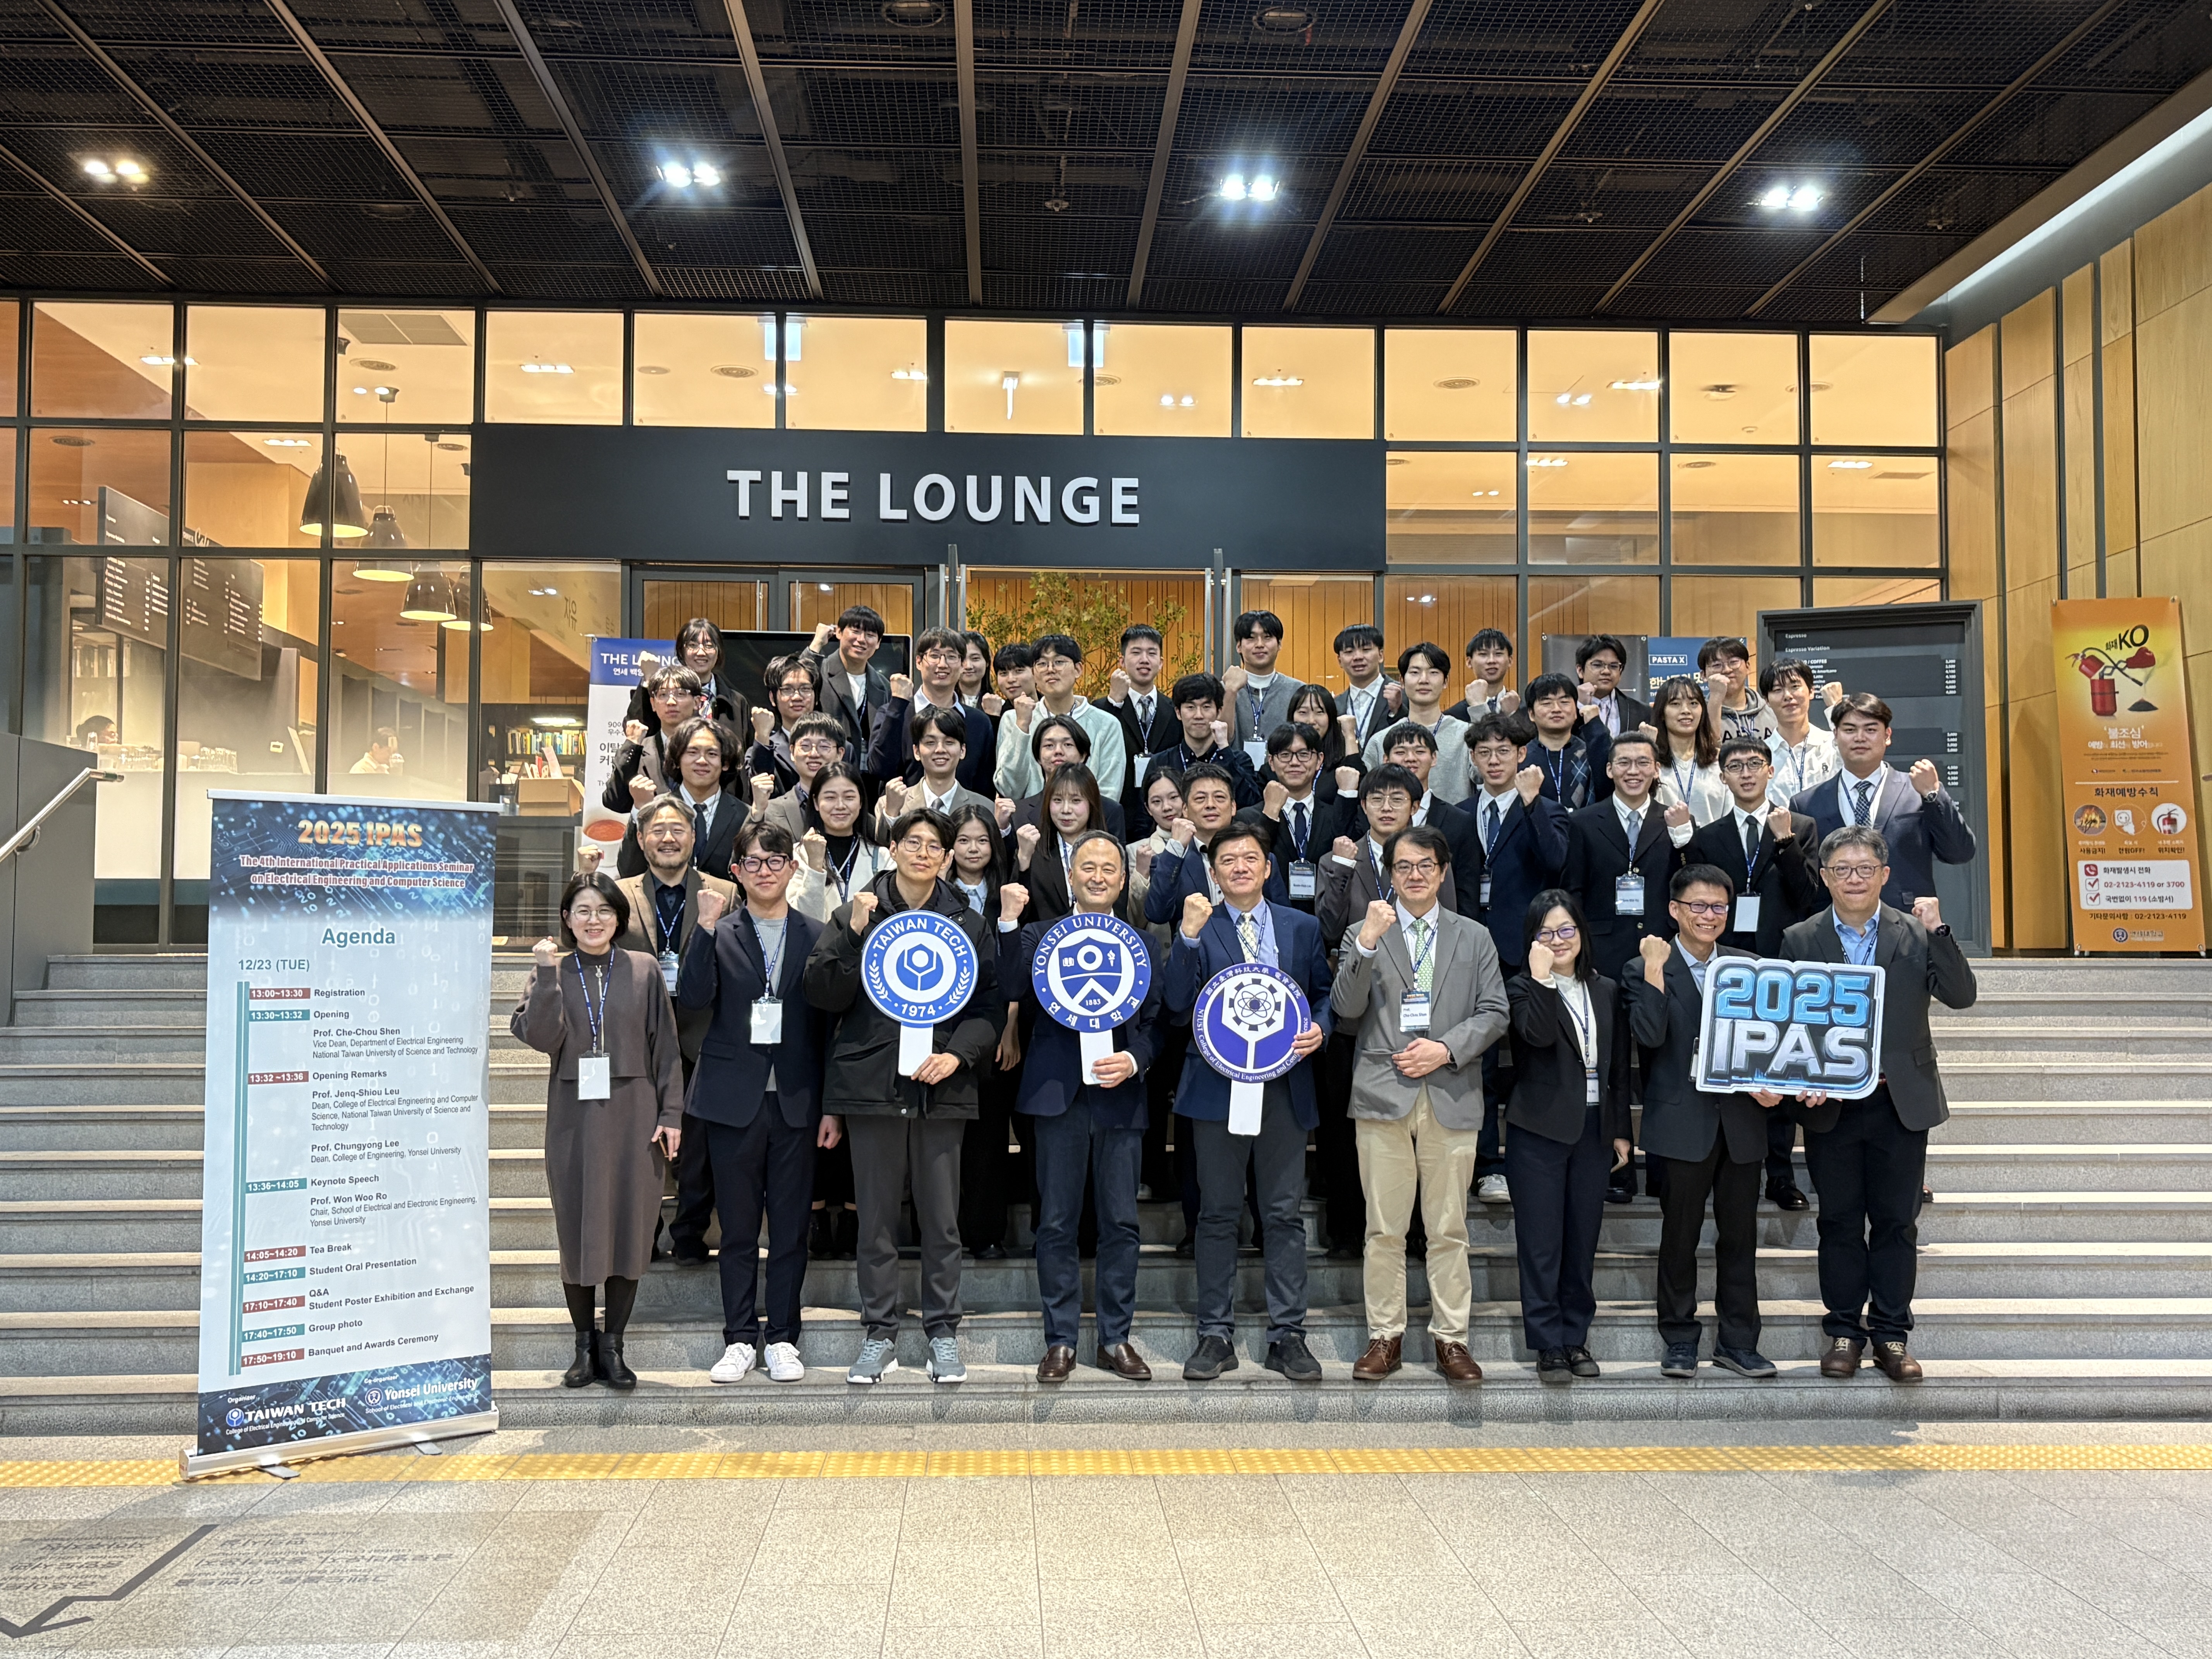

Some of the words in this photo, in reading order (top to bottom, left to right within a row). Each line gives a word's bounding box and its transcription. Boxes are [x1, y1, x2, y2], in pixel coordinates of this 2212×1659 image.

[727, 470, 850, 520] THE
[879, 473, 1140, 525] LOUNGE
[2118, 624, 2149, 650] KO
[601, 653, 628, 665] THE
[613, 667, 628, 676] 연세
[297, 819, 360, 845] 2025
[365, 821, 423, 847] IPAS
[240, 855, 259, 867] The
[259, 855, 275, 868] 4th
[276, 856, 338, 869] International
[339, 857, 382, 870] Practical
[382, 859, 438, 872] Applications
[438, 860, 474, 873] Seminar
[250, 874, 264, 884] on
[264, 873, 311, 885] Electrical
[311, 874, 368, 888] Engineering
[368, 876, 386, 886] and
[386, 876, 432, 889] Computer
[432, 876, 466, 888] Science
[322, 927, 395, 948] Agenda
[872, 918, 927, 951] TAIWAN
[934, 921, 967, 957] TECH
[1035, 924, 1068, 976] YONSEI
[1072, 916, 1147, 968] UNIVERSITY
[238, 959, 271, 970] 12/23
[276, 959, 310, 973] (TUE)
[251, 989, 303, 998] 13:00~13:30
[314, 989, 365, 998] Registration
[1716, 967, 1870, 1027] 2025
[251, 1011, 302, 1020] 13:30~13:32
[314, 1010, 349, 1020] Opening
[901, 1003, 936, 1017] 1974
[1048, 995, 1140, 1029] 연세대학교
[313, 1029, 333, 1037] Prof.
[336, 1028, 377, 1036] Che-Chou
[313, 1040, 327, 1048] Vice
[329, 1039, 348, 1048] Dean,
[350, 1038, 387, 1048] Department
[388, 1037, 395, 1046] of
[397, 1037, 425, 1045] Electrical
[427, 1036, 464, 1046] Engineering
[1712, 1018, 1869, 1077] IPAS
[313, 1050, 340, 1059] National
[366, 1049, 397, 1058] University
[405, 1048, 431, 1056] Science
[446, 1046, 478, 1055] Technology
[313, 1071, 348, 1081] Opening
[351, 1070, 387, 1079] Remarks
[1241, 1071, 1276, 1081] Engineering
[312, 1090, 332, 1099] Prof.
[335, 1089, 382, 1099] Jenq-Shiou
[333, 1100, 358, 1109] College
[359, 1099, 366, 1107] of
[368, 1098, 396, 1107] Electrical
[398, 1097, 436, 1106] Engineering
[450, 1094, 478, 1103] Computer
[342, 1110, 368, 1119] National
[393, 1107, 424, 1116] University
[434, 1106, 459, 1114] Science
[311, 1122, 349, 1132] Technology
[311, 1143, 331, 1152] Prof.
[334, 1142, 382, 1151] Chungyong
[332, 1153, 357, 1163] College
[359, 1152, 366, 1160] of
[367, 1150, 406, 1161] Engineering,
[407, 1148, 429, 1156] Yonsei
[431, 1147, 461, 1155] University
[247, 1180, 299, 1192] 13:36~14:05
[311, 1177, 346, 1187] Keynote
[349, 1174, 379, 1185] Speech
[310, 1207, 329, 1216] Chair,
[331, 1205, 354, 1214] School
[356, 1204, 362, 1212] of
[364, 1202, 392, 1212] Electrical
[393, 1201, 405, 1209] and
[407, 1199, 438, 1208] Electronic
[440, 1197, 477, 1207] Engineering,
[311, 1196, 331, 1206] Prof.
[333, 1195, 352, 1204] Won
[355, 1194, 373, 1202] Woo
[310, 1219, 332, 1227] Yonsei
[334, 1216, 366, 1225] University
[246, 1248, 298, 1261] 14:05~14:20
[327, 1243, 352, 1252] Break
[246, 1269, 298, 1282] 14:20~17:10
[309, 1265, 343, 1275] Student
[345, 1262, 363, 1272] Oral
[365, 1258, 417, 1270] Presentation
[244, 1298, 297, 1311] 17:10~17:40
[309, 1300, 342, 1310] Student
[345, 1297, 372, 1306] Poster
[374, 1291, 415, 1303] Exhibition
[417, 1288, 432, 1298] and
[435, 1286, 474, 1296] Exchange
[309, 1288, 329, 1297] Q&A
[244, 1326, 297, 1340] 17:40~17:50
[309, 1324, 336, 1332] Group
[338, 1320, 363, 1331] photo
[243, 1351, 296, 1365] 17:50~19:10
[308, 1345, 344, 1357] Banquet
[346, 1342, 362, 1352] and
[364, 1339, 395, 1350] Awards
[397, 1334, 439, 1345] Ceremony
[384, 1385, 421, 1401] Yonsei
[423, 1377, 477, 1395] University
[245, 1405, 304, 1422] TAIWAN
[311, 1397, 346, 1412] TECH
